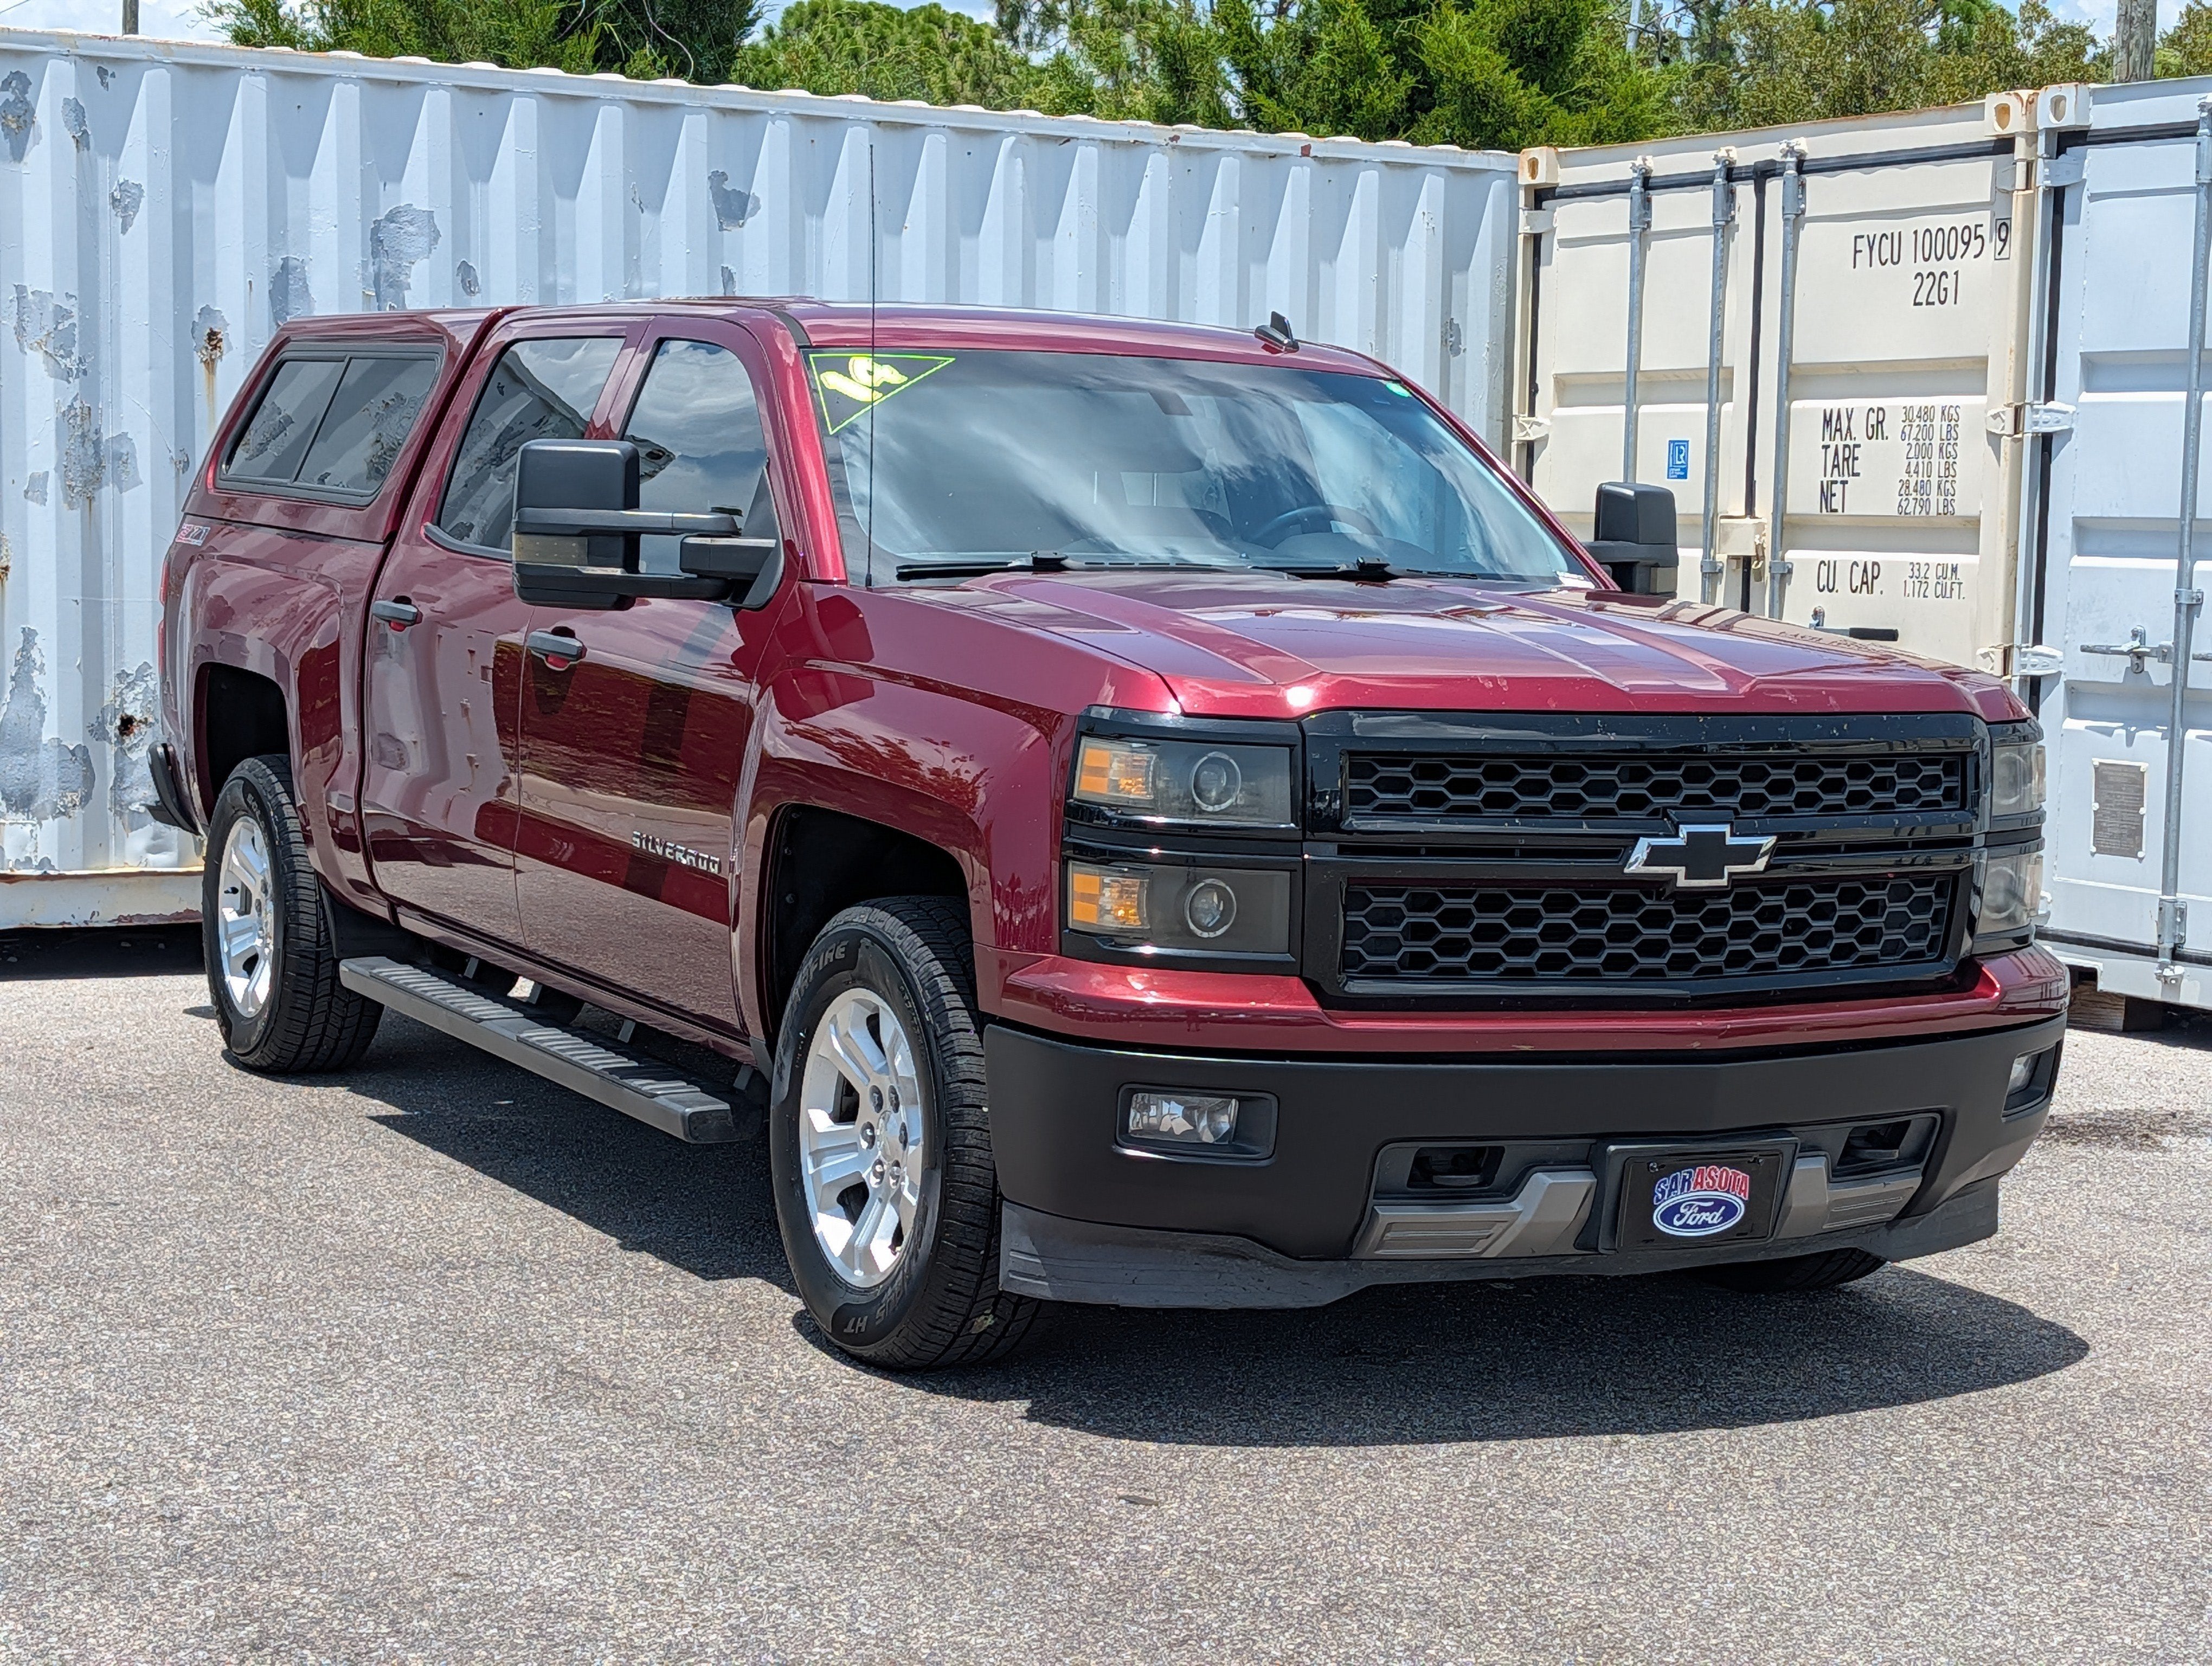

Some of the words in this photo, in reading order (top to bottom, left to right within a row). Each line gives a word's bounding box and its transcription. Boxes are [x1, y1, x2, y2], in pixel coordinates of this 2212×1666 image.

[1853, 230, 1902, 269] FYCU
[1913, 223, 1985, 264] 100095
[1913, 270, 1959, 306] 22G1
[1822, 408, 1856, 442] MAX.
[1866, 407, 1889, 440] GR.
[1941, 405, 1960, 422] KGS
[1939, 424, 1959, 441] LBS
[1822, 444, 1861, 477] TARE
[1938, 443, 1958, 459] KGS
[1938, 461, 1957, 478] LBS
[1819, 480, 1849, 513] NET
[1937, 479, 1957, 497] KGS
[1936, 498, 1956, 516] LBS
[1817, 560, 1839, 593] CU.
[1849, 561, 1884, 595] CAP.
[632, 830, 722, 874] SILVERADO
[1654, 1165, 1750, 1205] SARASOTA
[1673, 1201, 1726, 1226] Ford
